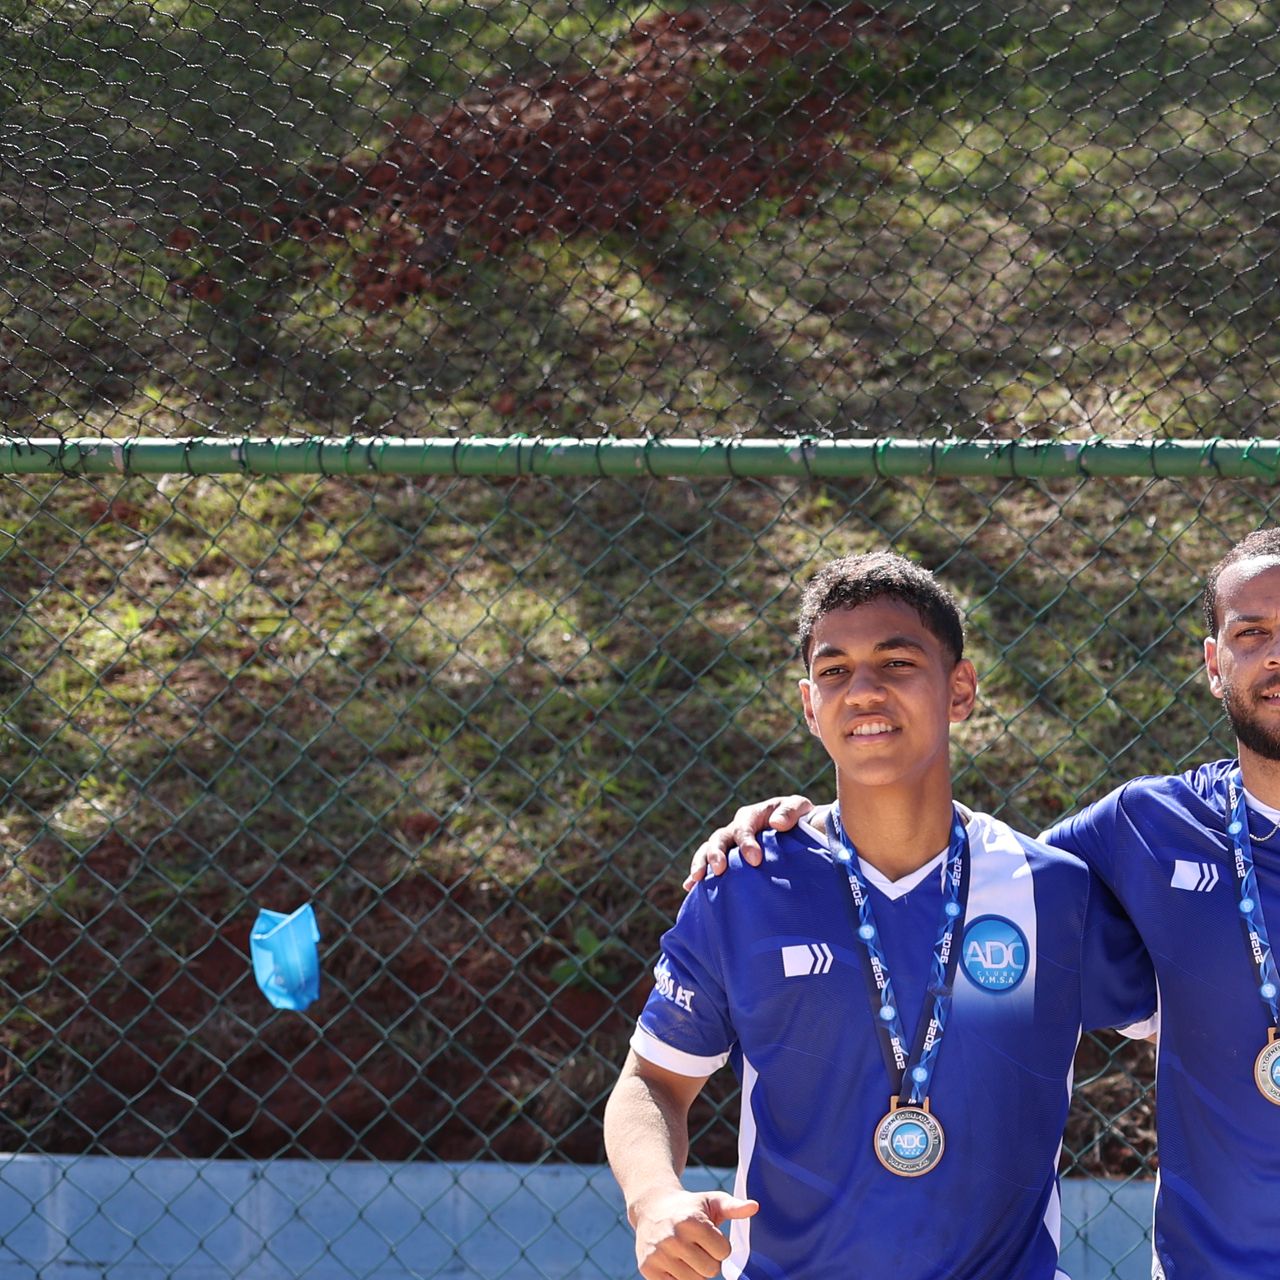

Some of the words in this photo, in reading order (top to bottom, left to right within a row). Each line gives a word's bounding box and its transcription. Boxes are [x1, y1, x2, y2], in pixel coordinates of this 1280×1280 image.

[952, 857, 962, 887] 2026
[1234, 848, 1246, 878] 2026
[848, 875, 864, 906] 2026
[940, 932, 953, 964] 2026
[965, 941, 1023, 968] ADC
[1249, 932, 1264, 964] 2026
[870, 956, 886, 989] 2026
[923, 1018, 938, 1051] 2026
[890, 1037, 906, 1070] 2026
[893, 1134, 926, 1148] ADC
